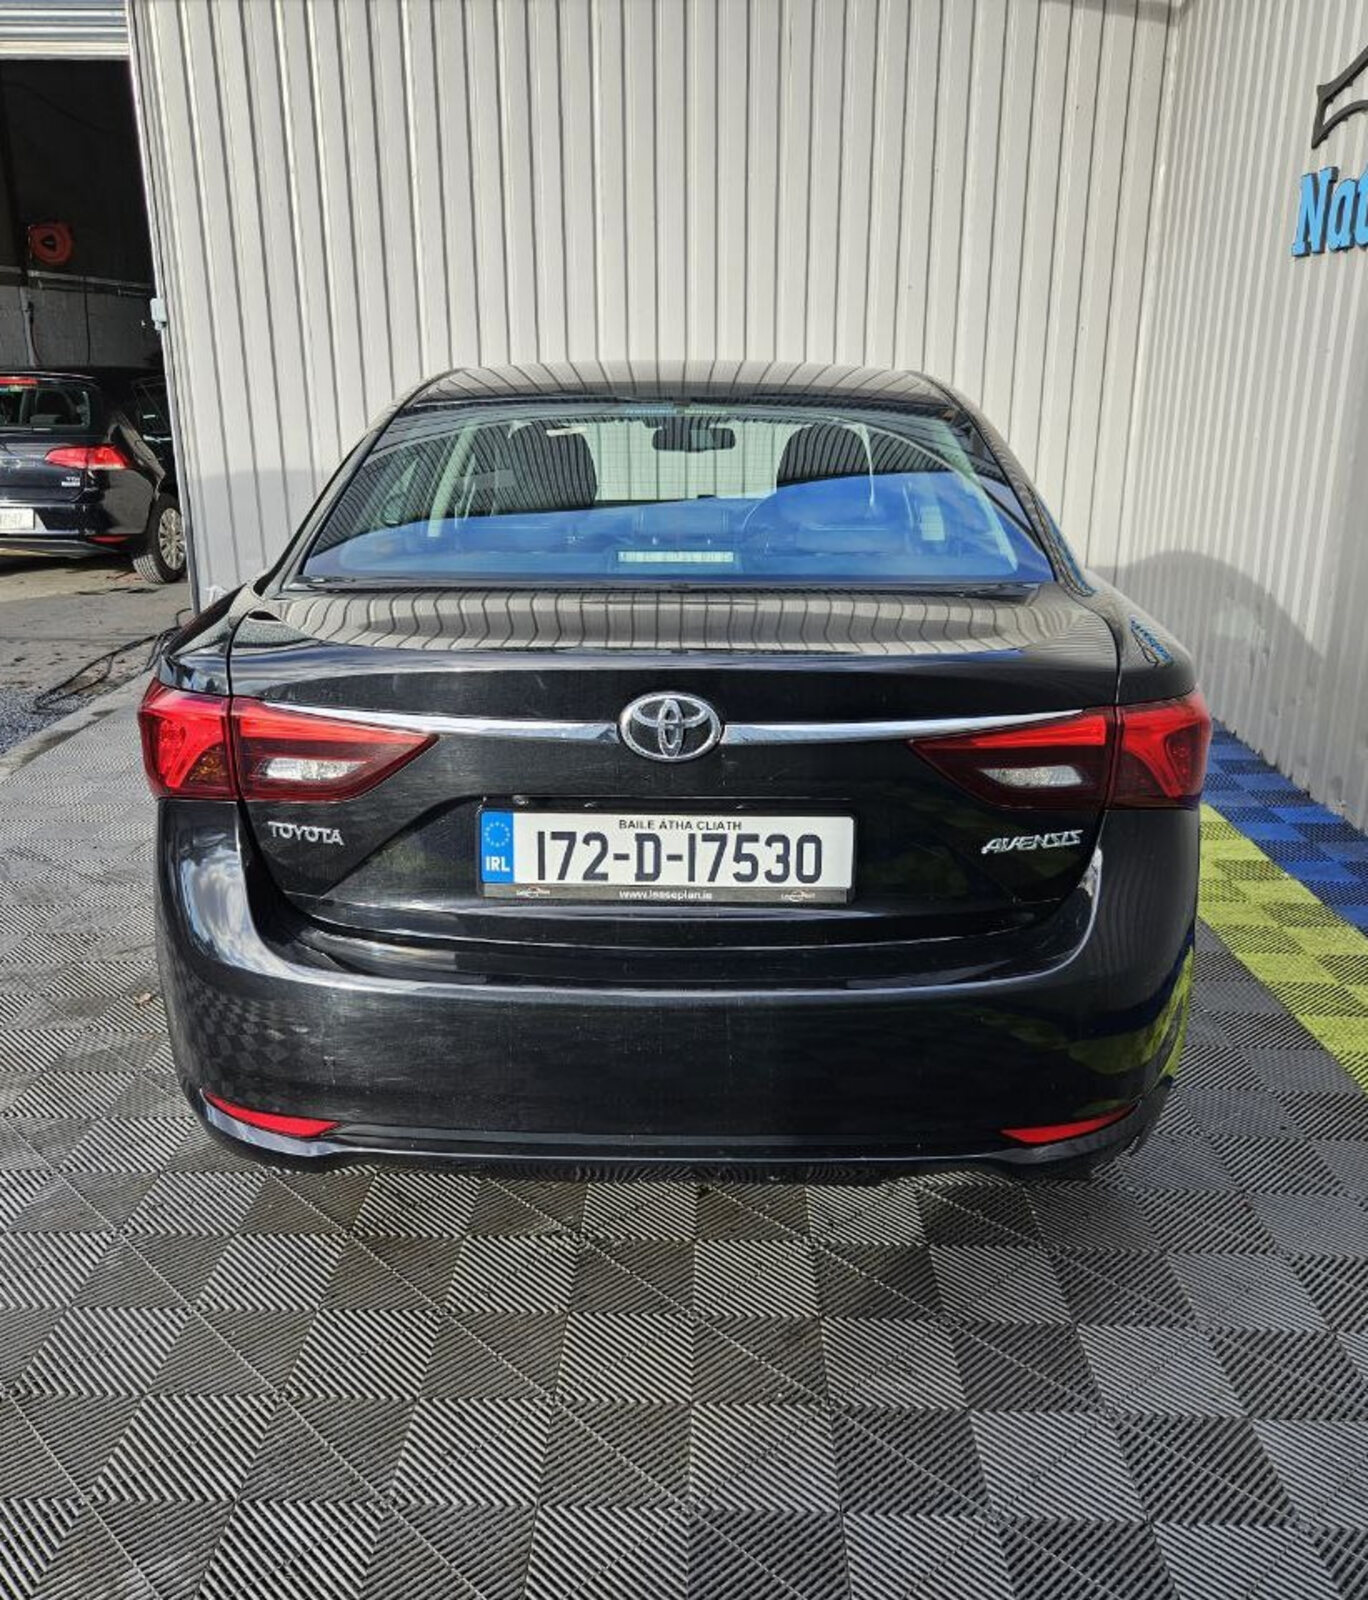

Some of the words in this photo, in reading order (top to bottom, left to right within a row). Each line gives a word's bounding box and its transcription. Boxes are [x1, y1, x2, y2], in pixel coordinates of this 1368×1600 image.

[267, 821, 345, 846] TOYOTA
[618, 819, 655, 830] BAILE
[696, 821, 742, 831] CLIATH
[980, 829, 1084, 854] AVENSIS
[485, 855, 511, 872] IRL
[536, 831, 823, 884] 172-D-17530
[618, 889, 713, 901] www.leaseplan.ie
